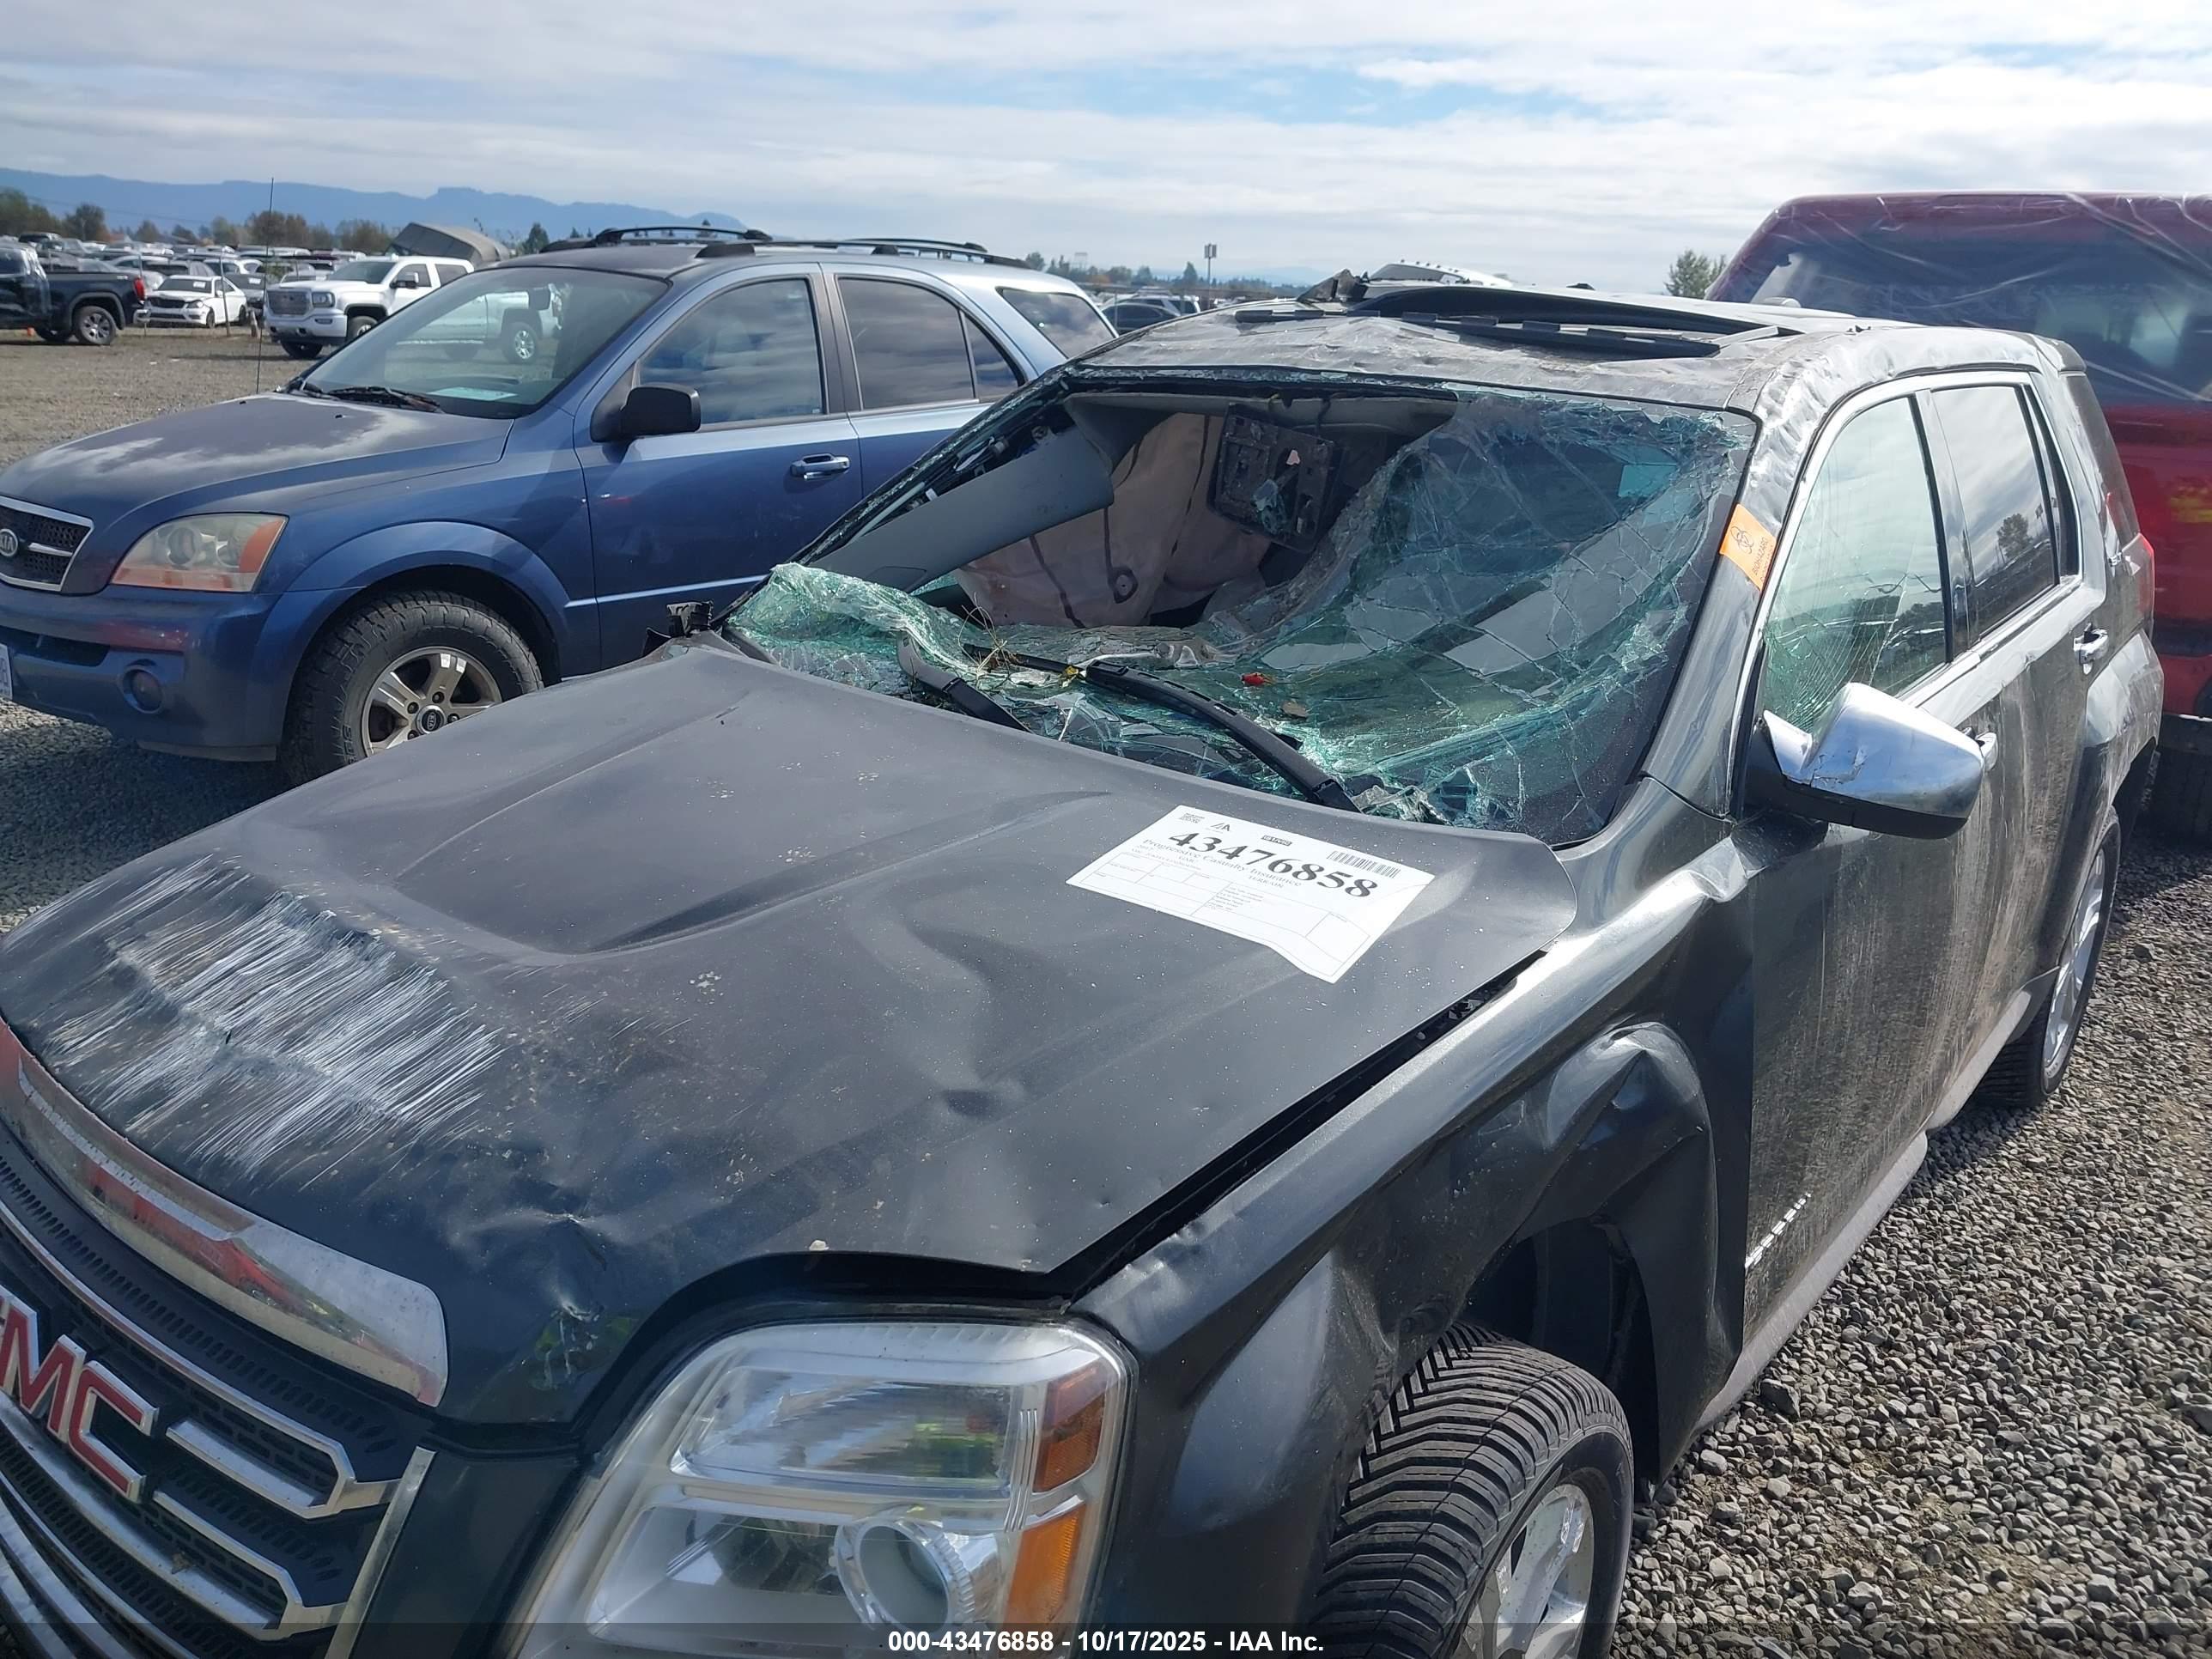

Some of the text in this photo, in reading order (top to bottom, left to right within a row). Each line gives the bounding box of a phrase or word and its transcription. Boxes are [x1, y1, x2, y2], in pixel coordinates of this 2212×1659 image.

[1143, 839, 1202, 859] Progressive
[1202, 855, 1249, 872] Casualty
[1250, 867, 1303, 887] Insurance
[1169, 832, 1378, 897] 43476858
[0, 1285, 160, 1504] MC
